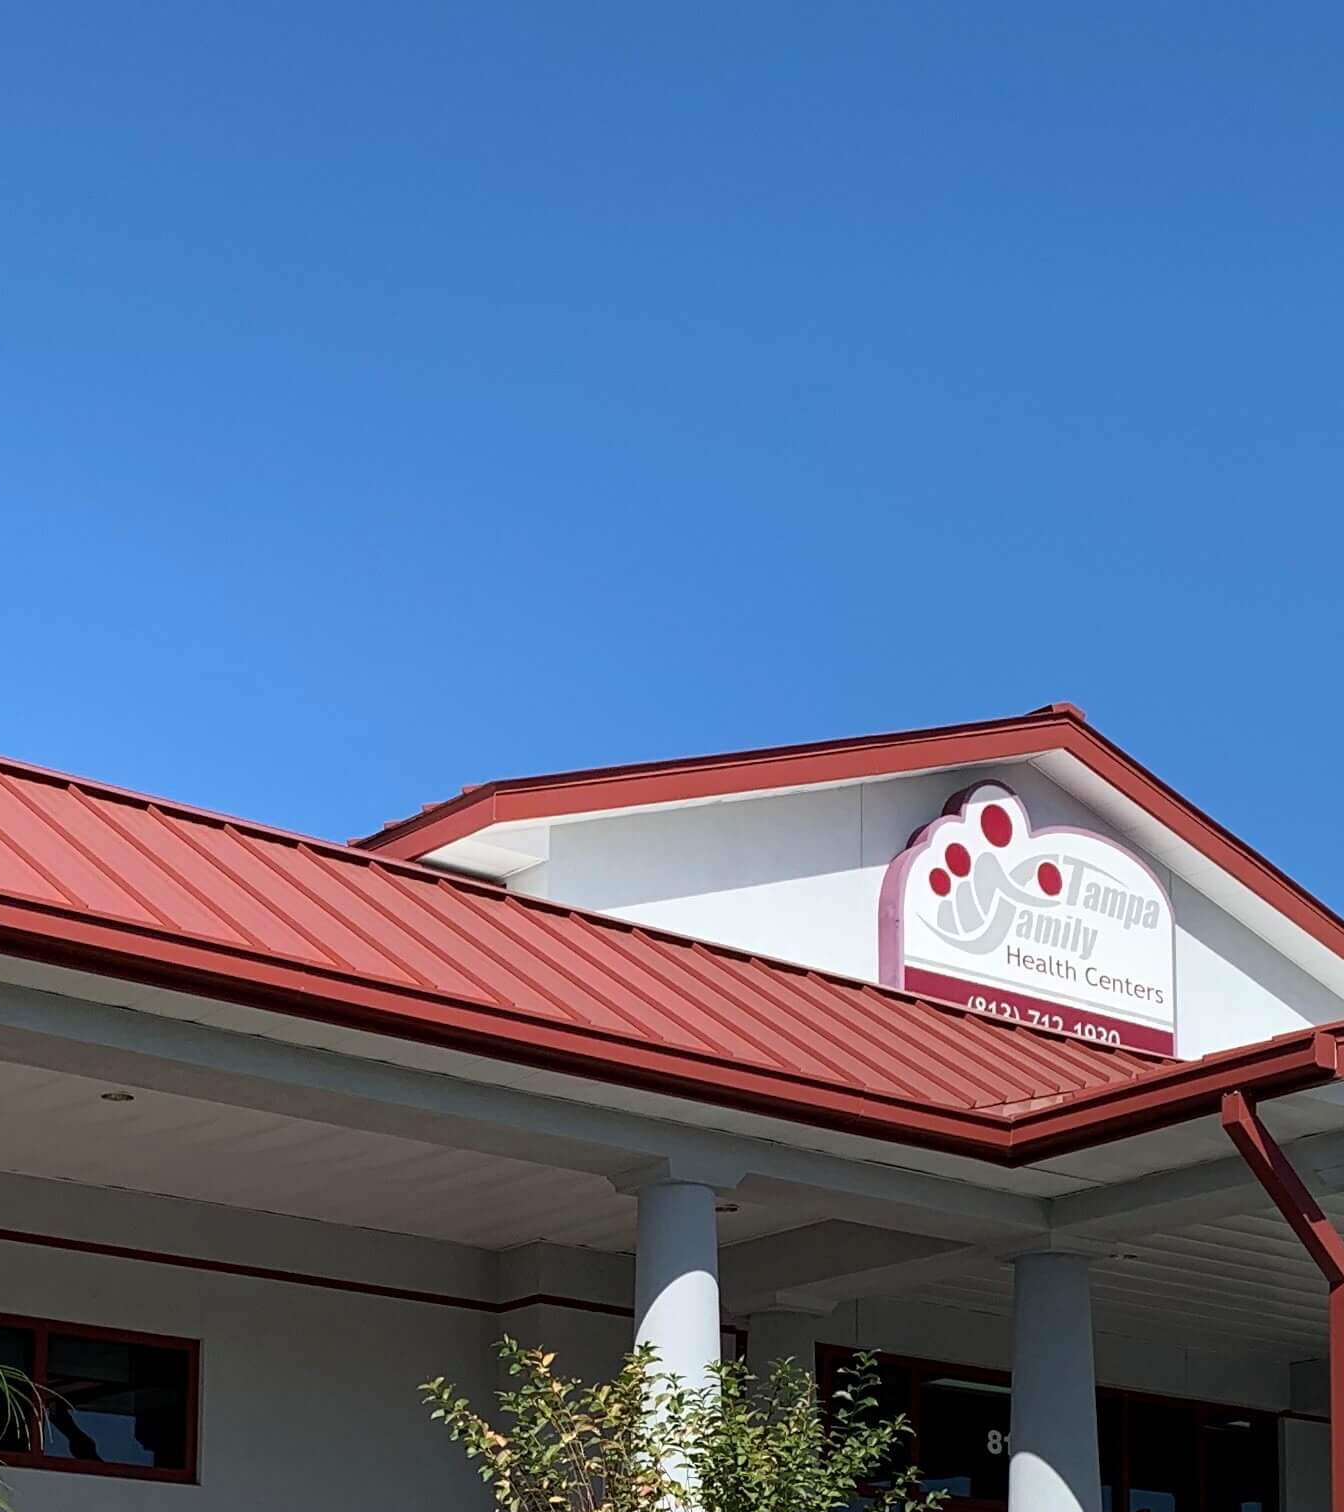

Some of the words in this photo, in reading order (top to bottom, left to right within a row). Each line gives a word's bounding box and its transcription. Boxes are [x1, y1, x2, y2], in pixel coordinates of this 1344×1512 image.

[1064, 853, 1161, 930] Tampa
[1006, 944, 1077, 982] Health
[1084, 966, 1164, 1004] Centers
